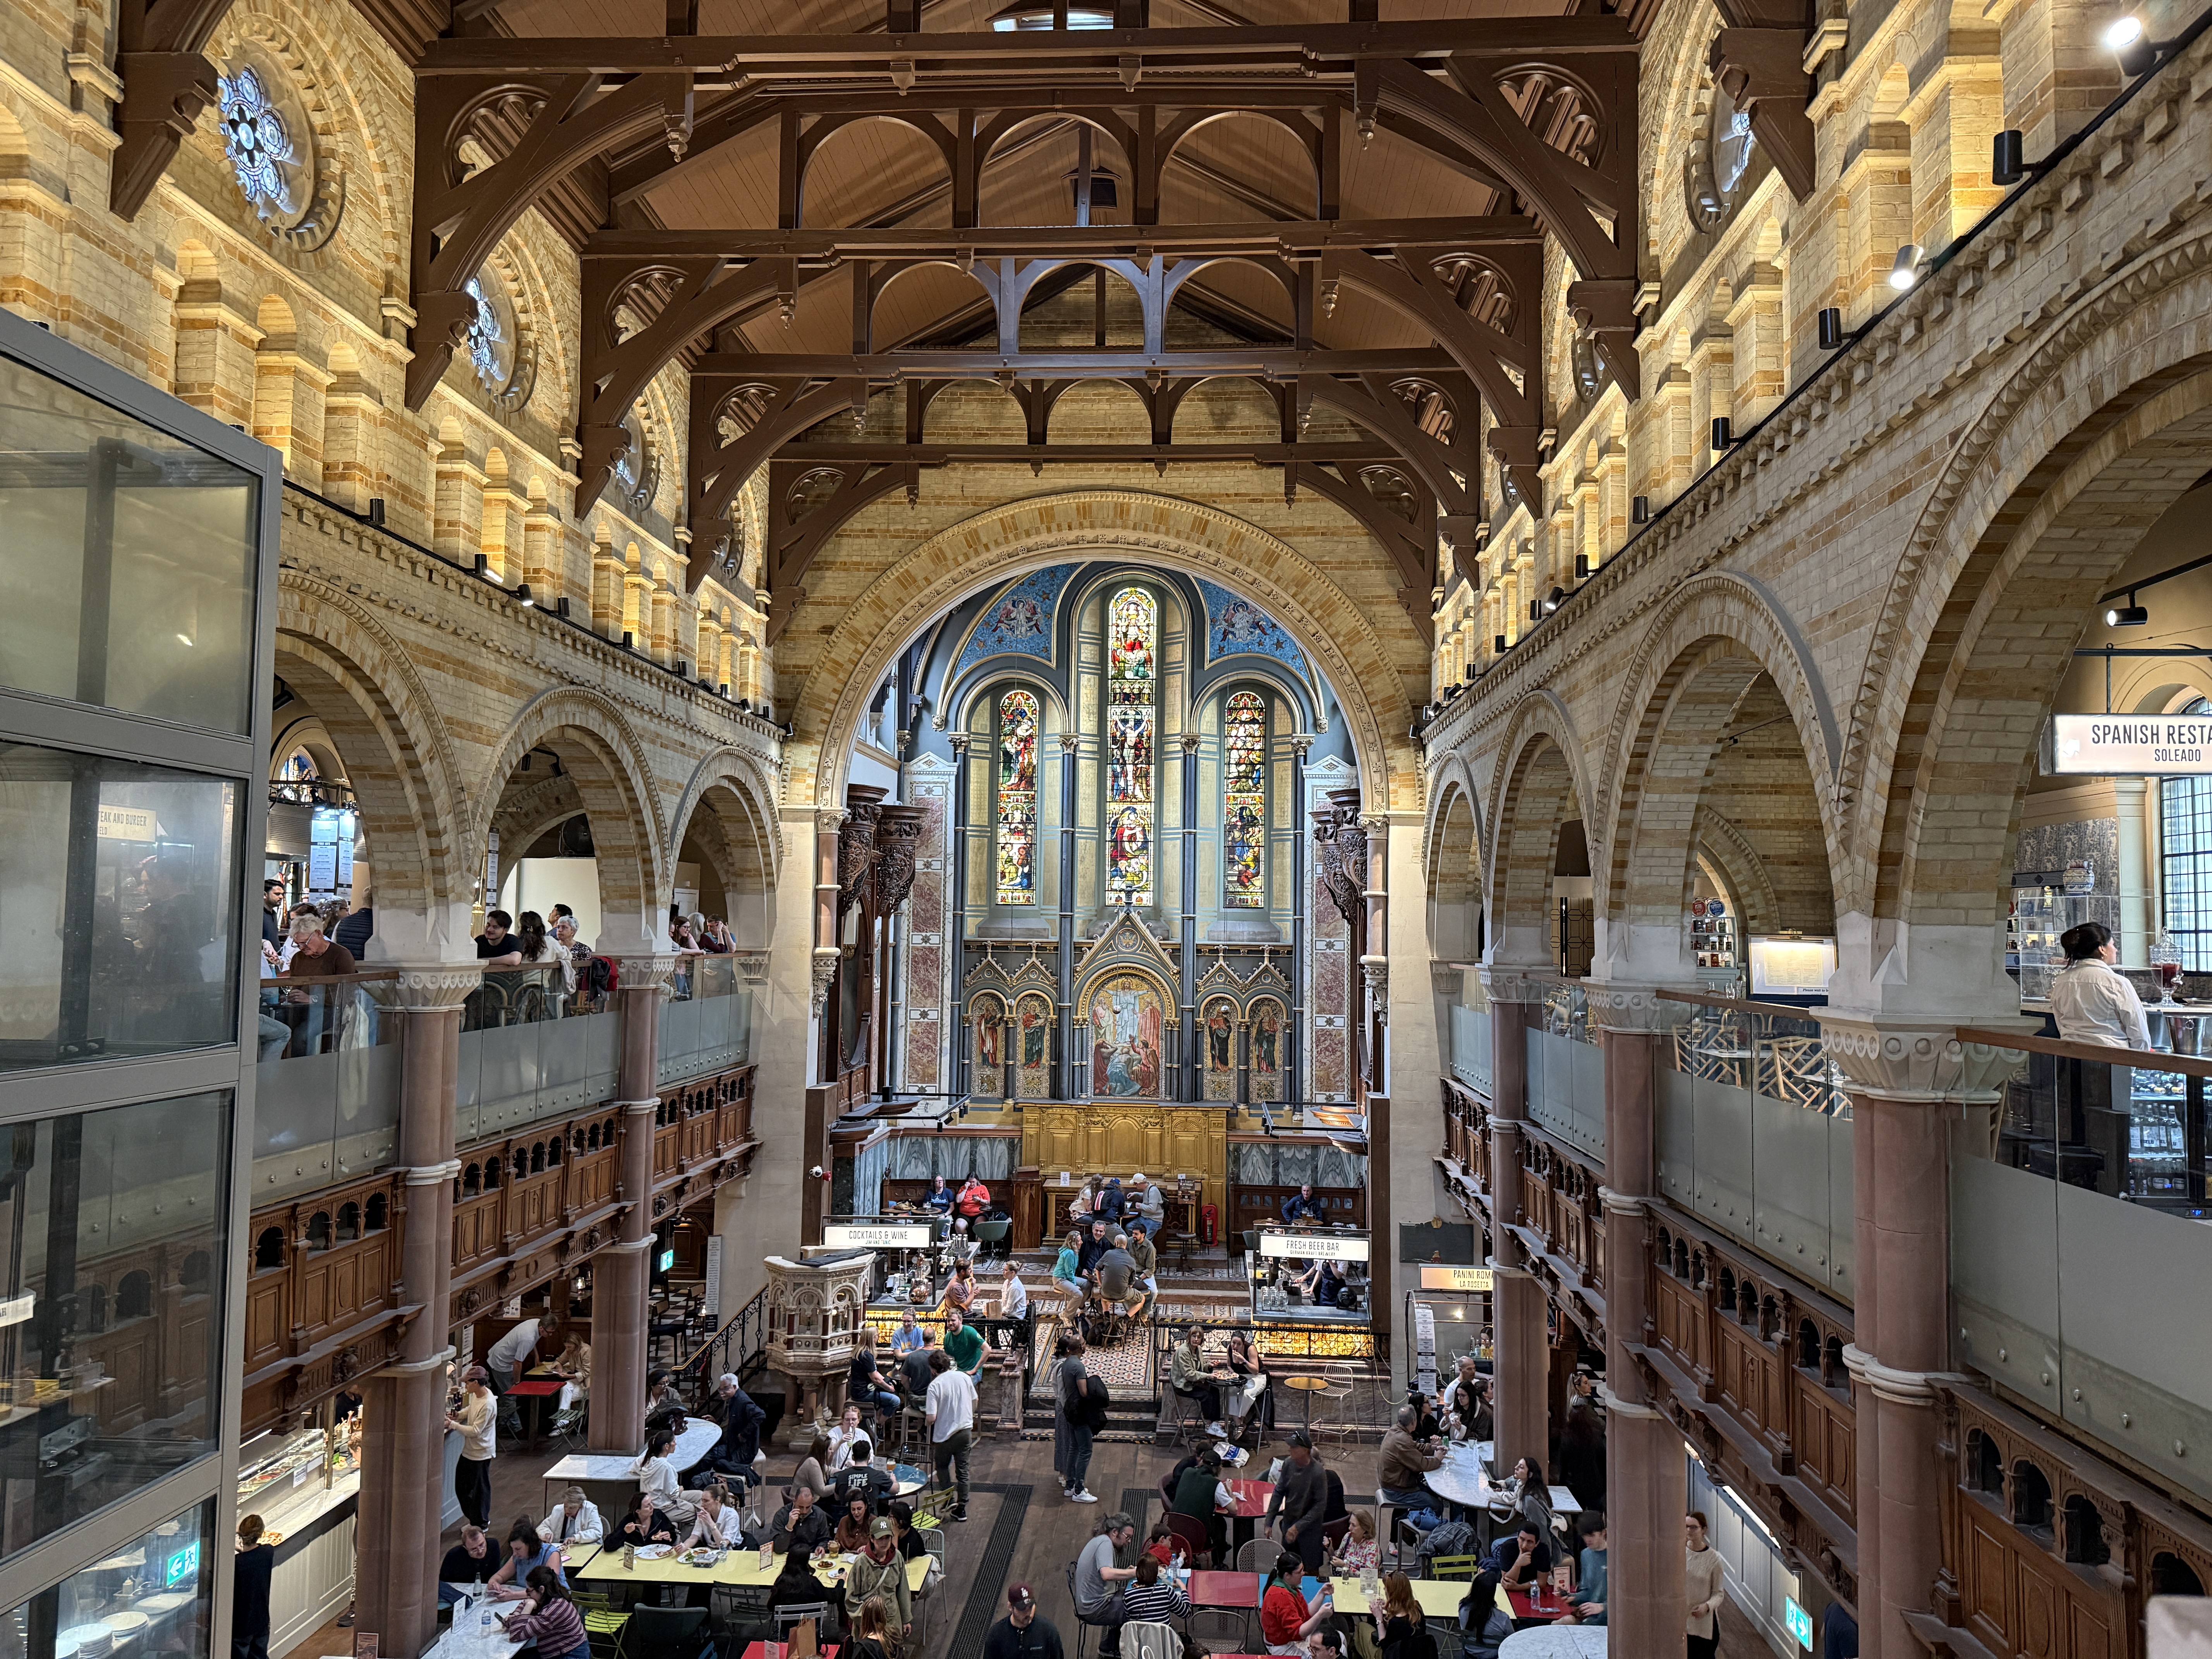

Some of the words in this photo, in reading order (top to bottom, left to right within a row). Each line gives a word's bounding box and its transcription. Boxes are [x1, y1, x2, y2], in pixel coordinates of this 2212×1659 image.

[2092, 724, 2159, 744] SPANISH
[2155, 749, 2201, 762] SOLEADO
[113, 813, 124, 824] AND
[126, 814, 147, 827] BURGER
[849, 1230, 882, 1239] COCKTAILS
[891, 1231, 908, 1240] WINE
[1286, 1240, 1306, 1249] FRESH
[1309, 1241, 1324, 1250] BEER
[1327, 1242, 1339, 1251] BAR
[1454, 1270, 1474, 1279] PANINI
[848, 1478, 868, 1487] LIFE
